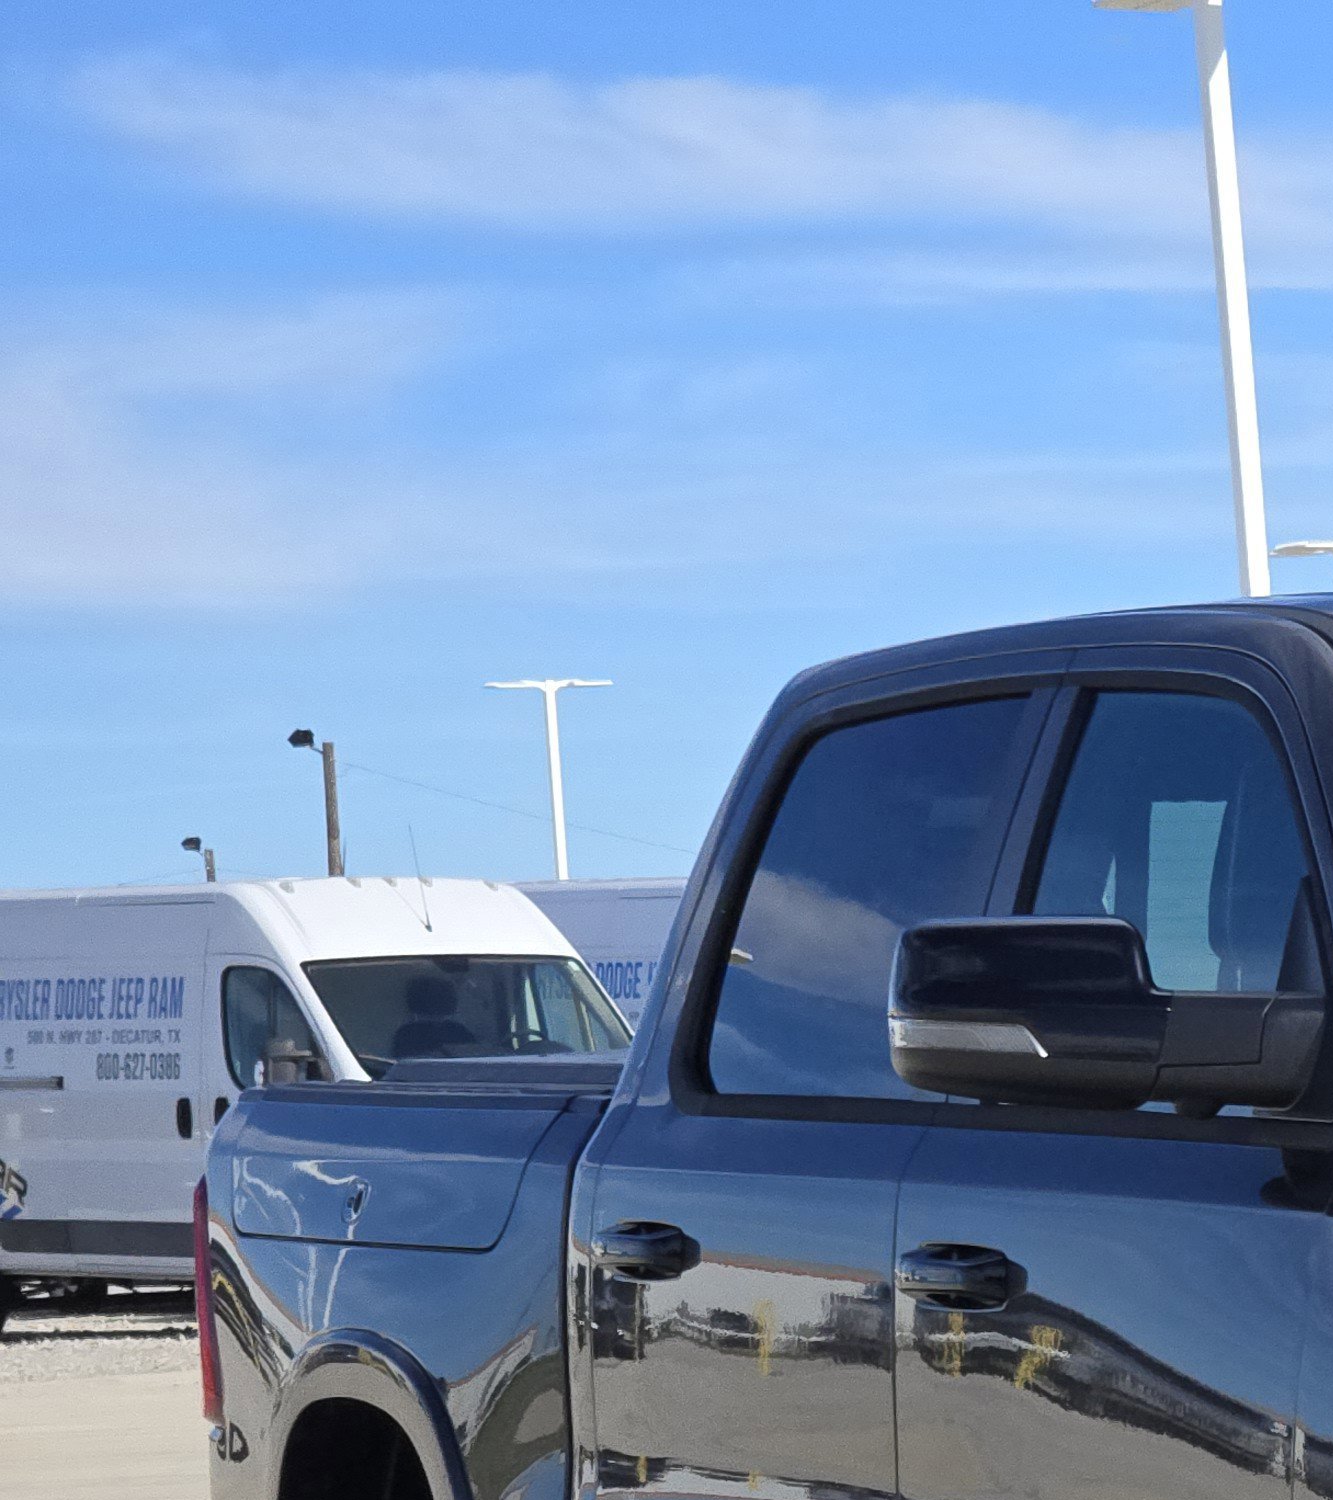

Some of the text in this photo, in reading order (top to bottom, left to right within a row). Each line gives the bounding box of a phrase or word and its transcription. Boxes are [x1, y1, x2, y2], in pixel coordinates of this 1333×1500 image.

[55, 978, 105, 1021] DODGE
[109, 977, 145, 1020] JEEP
[147, 976, 184, 1019] RAM
[167, 1029, 181, 1043] TX
